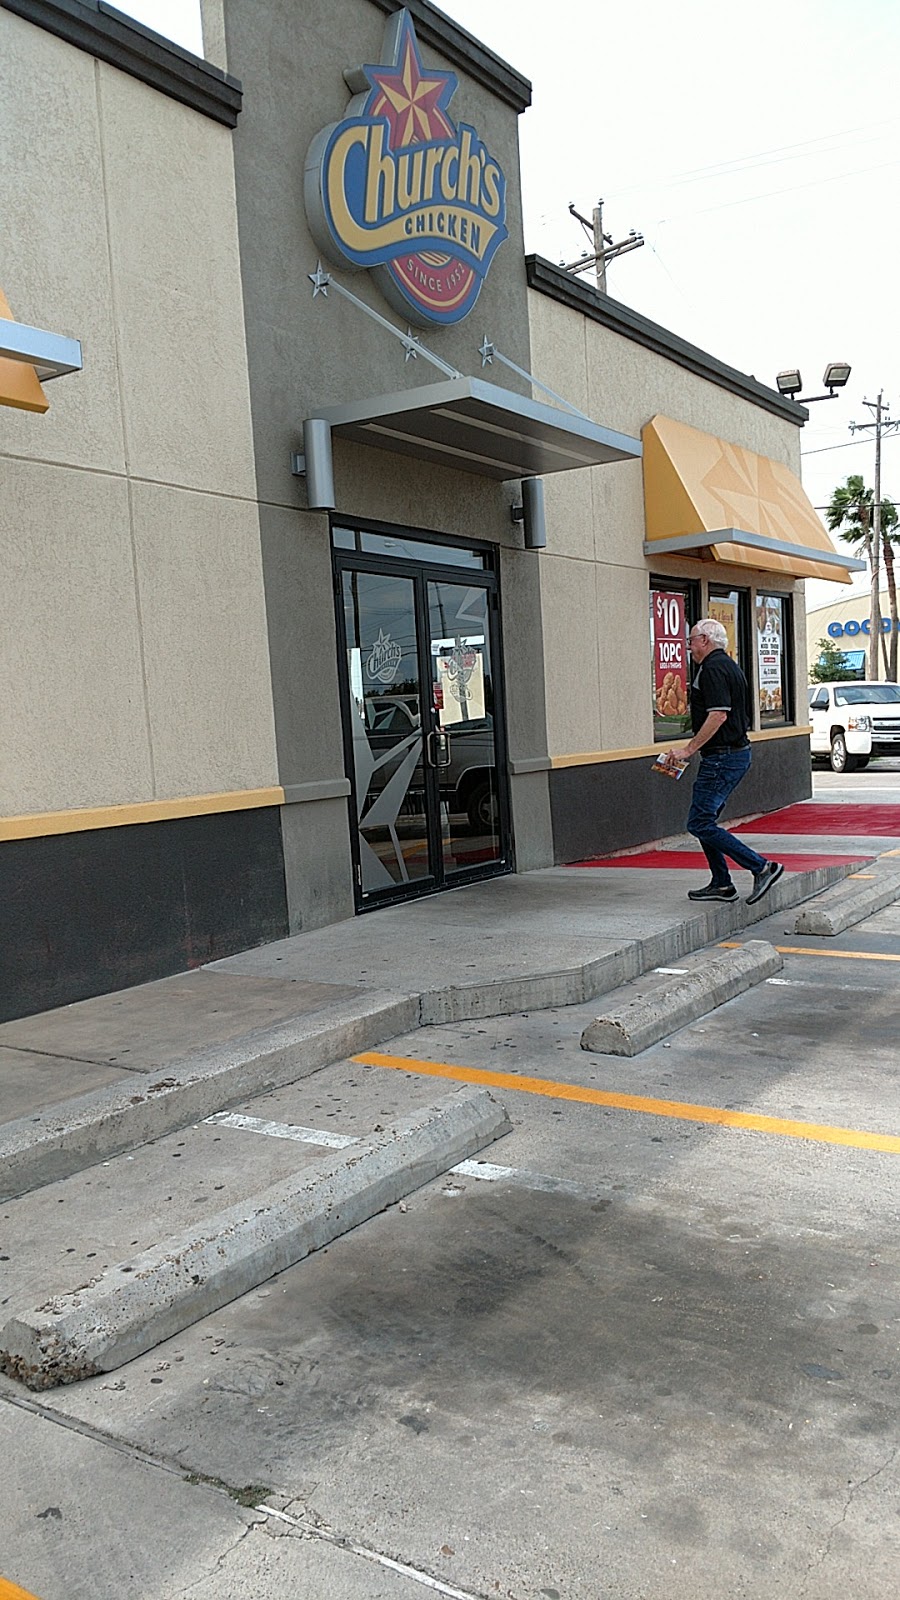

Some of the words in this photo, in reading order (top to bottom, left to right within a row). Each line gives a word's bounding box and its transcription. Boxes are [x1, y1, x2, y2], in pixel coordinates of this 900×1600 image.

[327, 123, 501, 251] Church's
[404, 211, 481, 253] CHICKEN
[407, 258, 443, 292] SINCE
[446, 262, 465, 291] 1952
[656, 595, 680, 636] $10
[659, 642, 682, 662] 10PC
